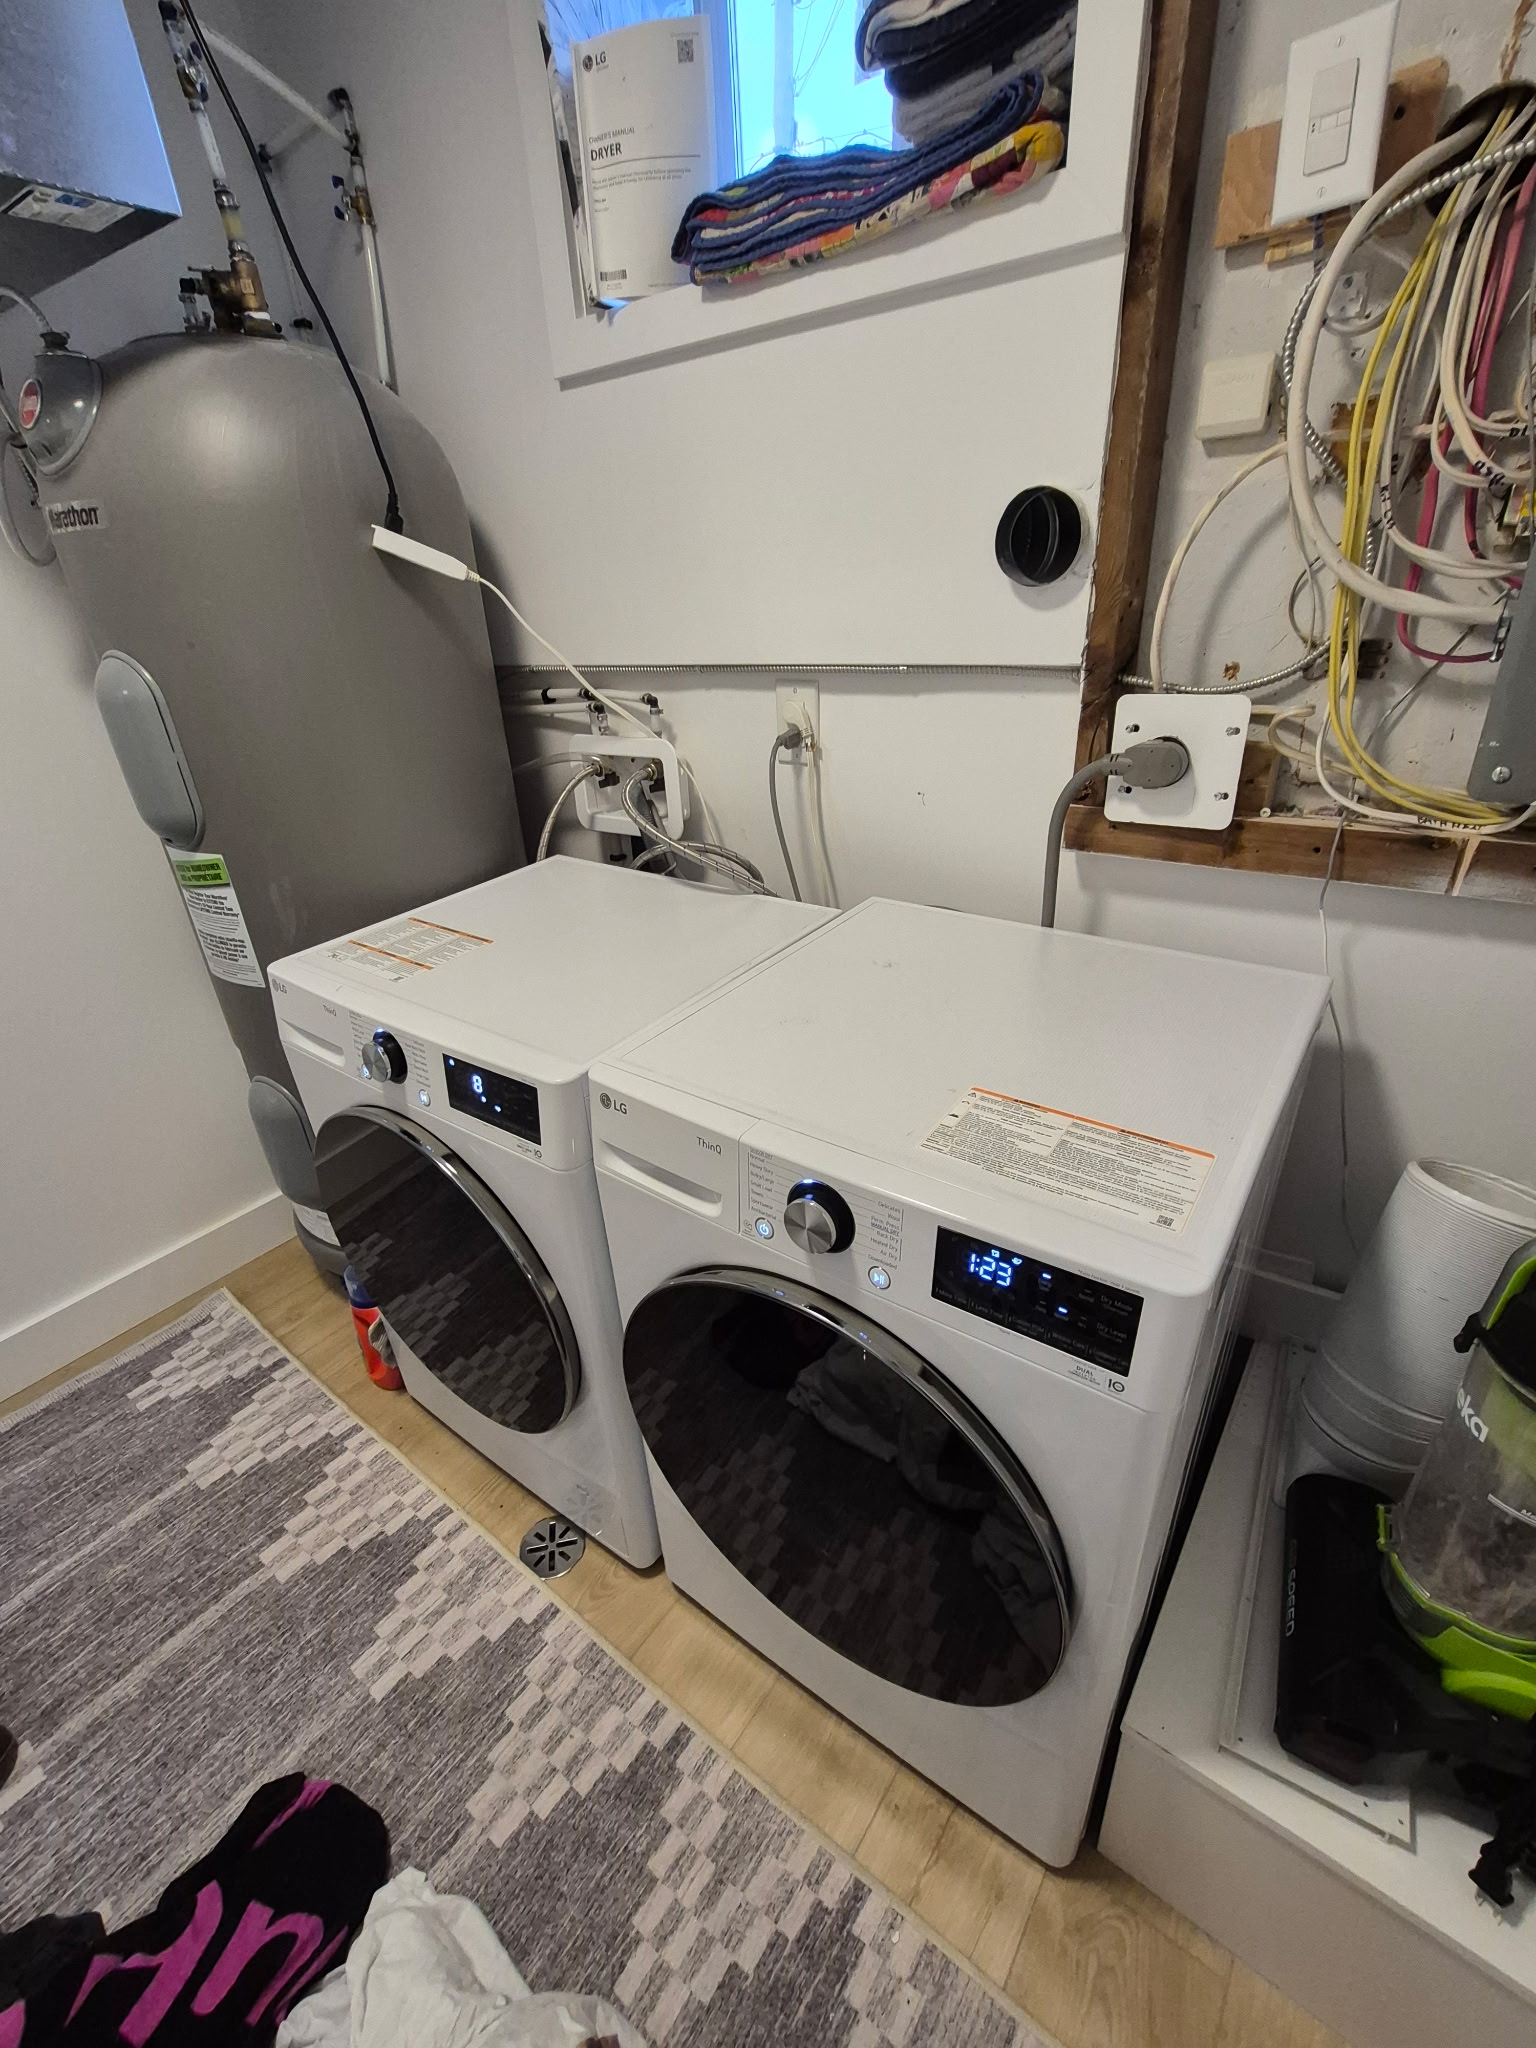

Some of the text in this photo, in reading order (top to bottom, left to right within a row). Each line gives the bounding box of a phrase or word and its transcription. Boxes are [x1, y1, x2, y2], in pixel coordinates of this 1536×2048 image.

[595, 51, 607, 66] LG
[612, 127, 635, 138] MANUAL
[590, 142, 622, 161] DRYER
[472, 1074, 483, 1094] 8
[613, 1099, 628, 1115] LG
[696, 1135, 722, 1156] ThinQ
[970, 1253, 1012, 1287] 1:23
[1076, 1365, 1094, 1377] DUAL
